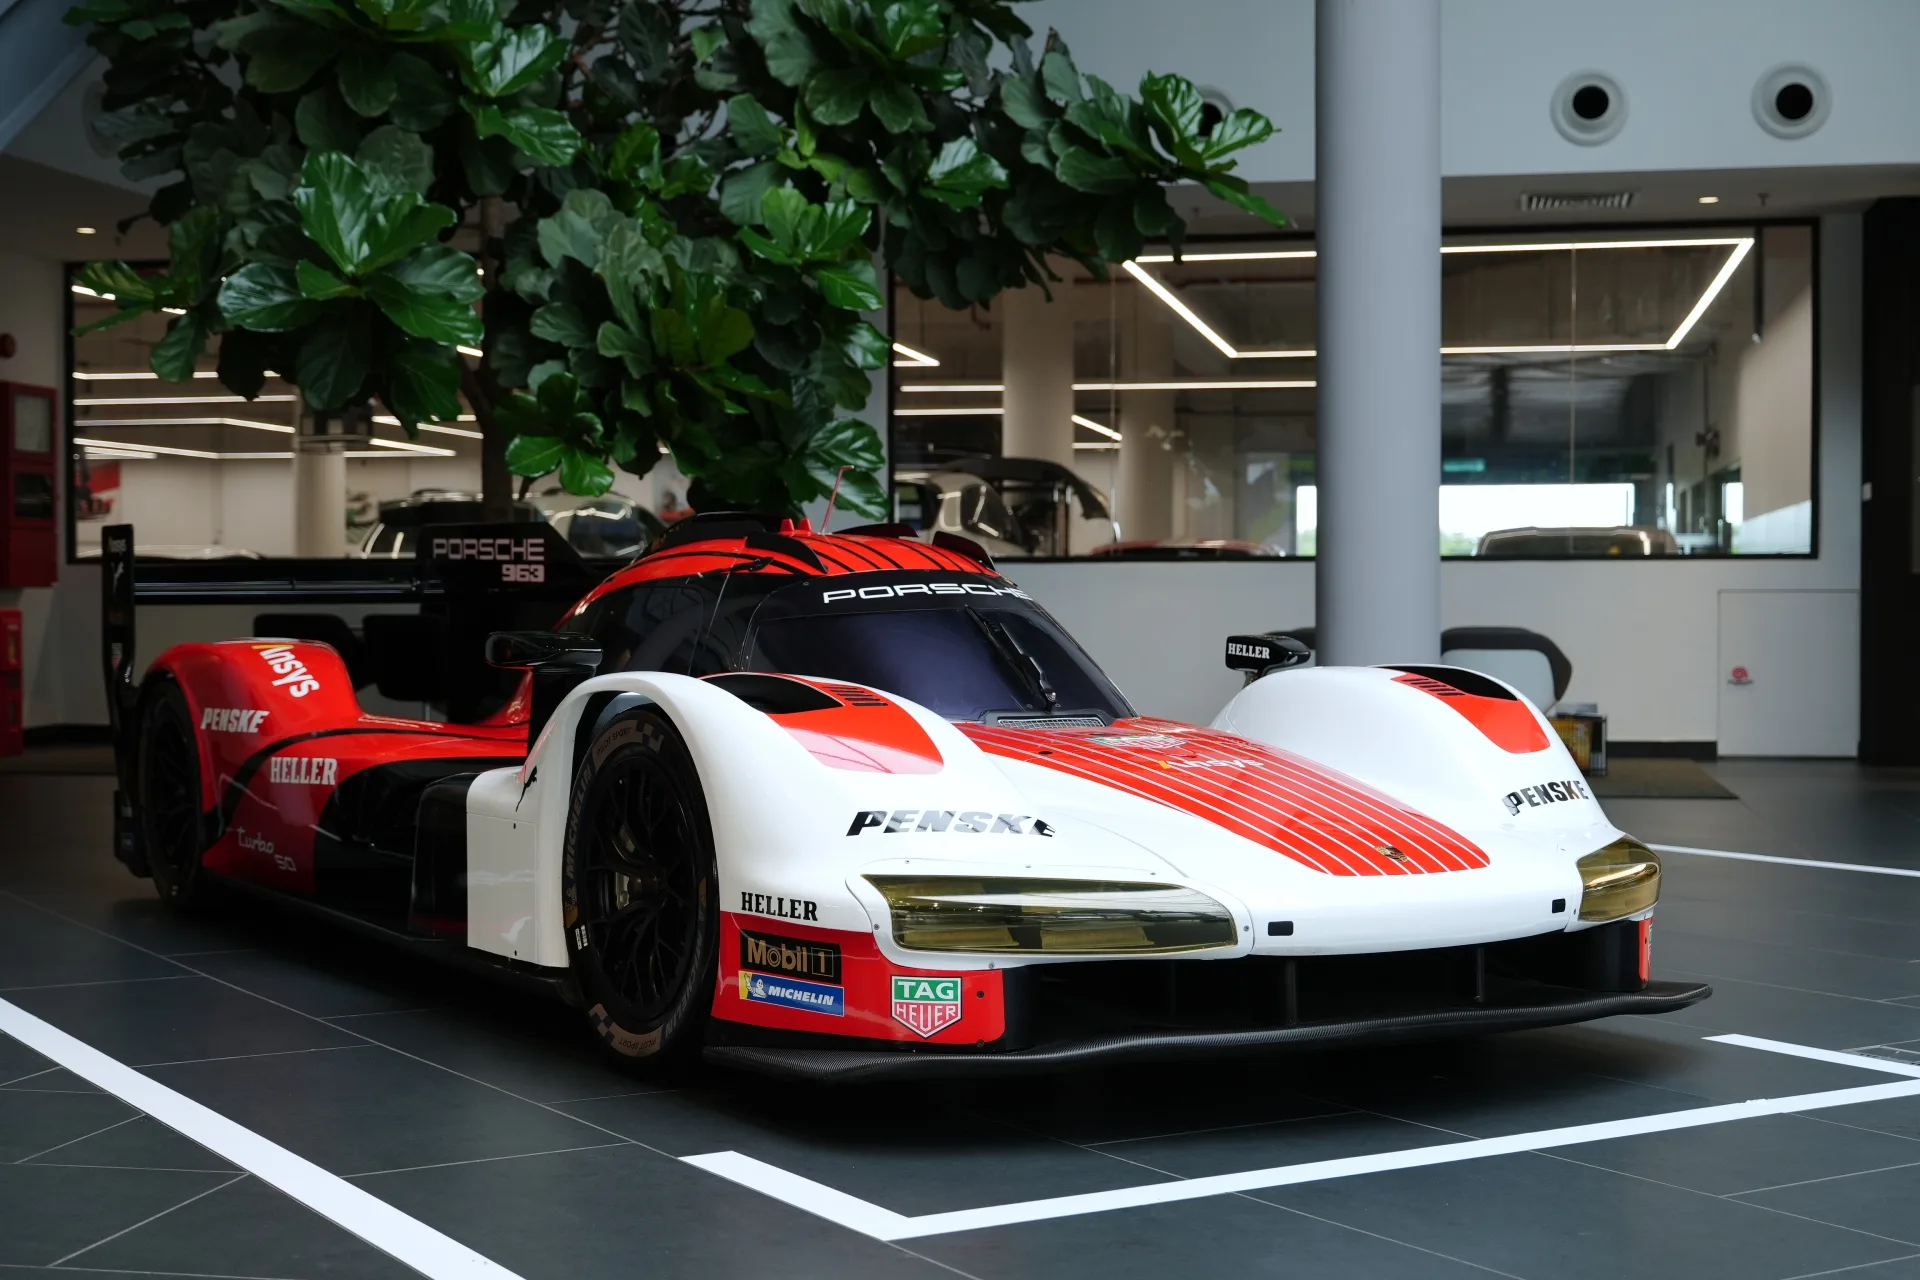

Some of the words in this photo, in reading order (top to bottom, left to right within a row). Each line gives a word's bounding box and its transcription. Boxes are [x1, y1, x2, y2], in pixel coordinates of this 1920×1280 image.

[432, 537, 545, 561] PORSCHE
[501, 563, 545, 583] 963
[822, 583, 1033, 604] PORSCHE
[1228, 643, 1270, 660] HELLER
[251, 644, 320, 698] Ansys
[200, 707, 270, 734] PENSKE
[597, 736, 611, 756] PILOT
[612, 727, 631, 743] SPORT
[270, 756, 337, 785] HELLER
[1502, 780, 1589, 817] PENSKE
[565, 763, 593, 880] MICHELIN
[846, 810, 1056, 838] PENSKE
[741, 891, 818, 921] HELLER
[747, 937, 807, 973] Mobil
[768, 985, 834, 1006] MICHELIN
[897, 981, 954, 1000] TAG
[896, 1003, 956, 1032] HEUER
